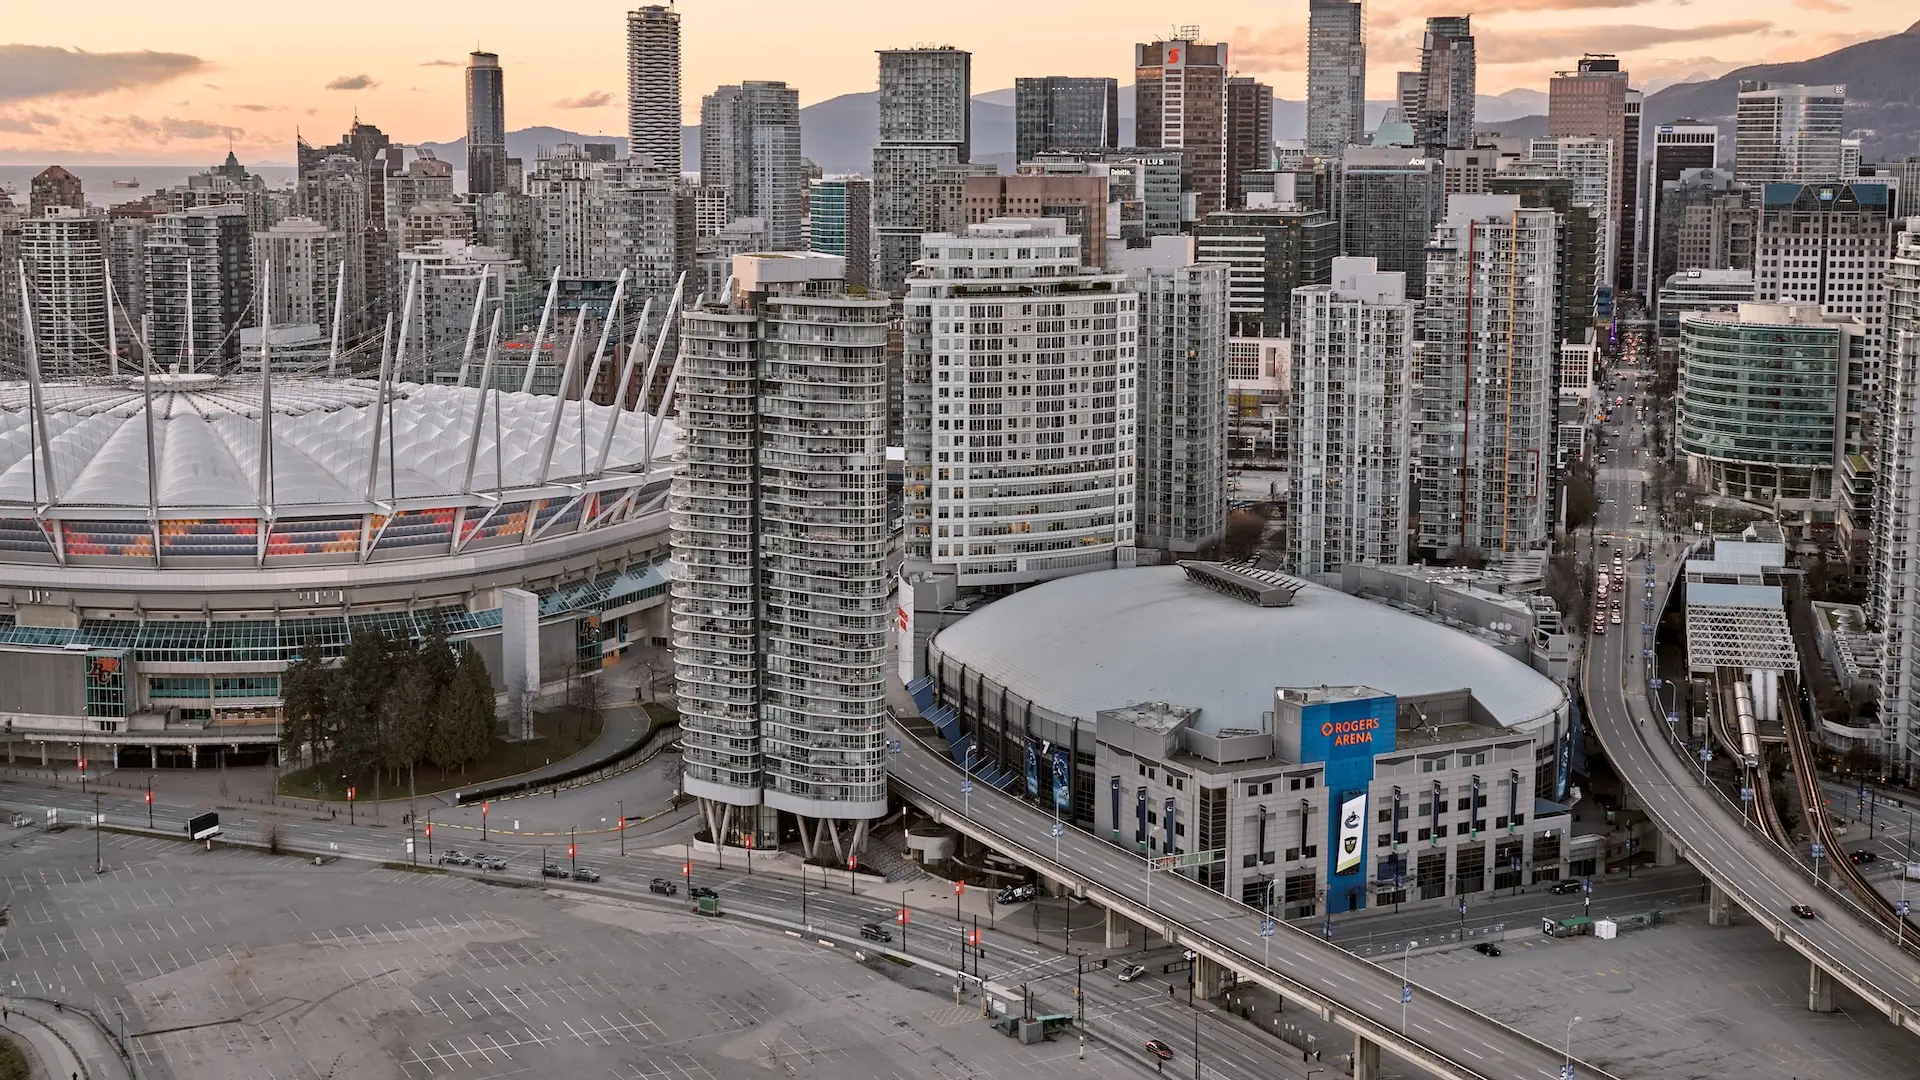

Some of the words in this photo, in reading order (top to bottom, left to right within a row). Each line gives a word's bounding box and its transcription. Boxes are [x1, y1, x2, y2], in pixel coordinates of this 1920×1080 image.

[1136, 158, 1164, 166] TELUS
[1335, 718, 1380, 733] ROGERS
[1334, 731, 1373, 747] ARENA
[1042, 740, 1051, 755] 7
[1544, 830, 1551, 838] 4
[1544, 922, 1551, 932] P
